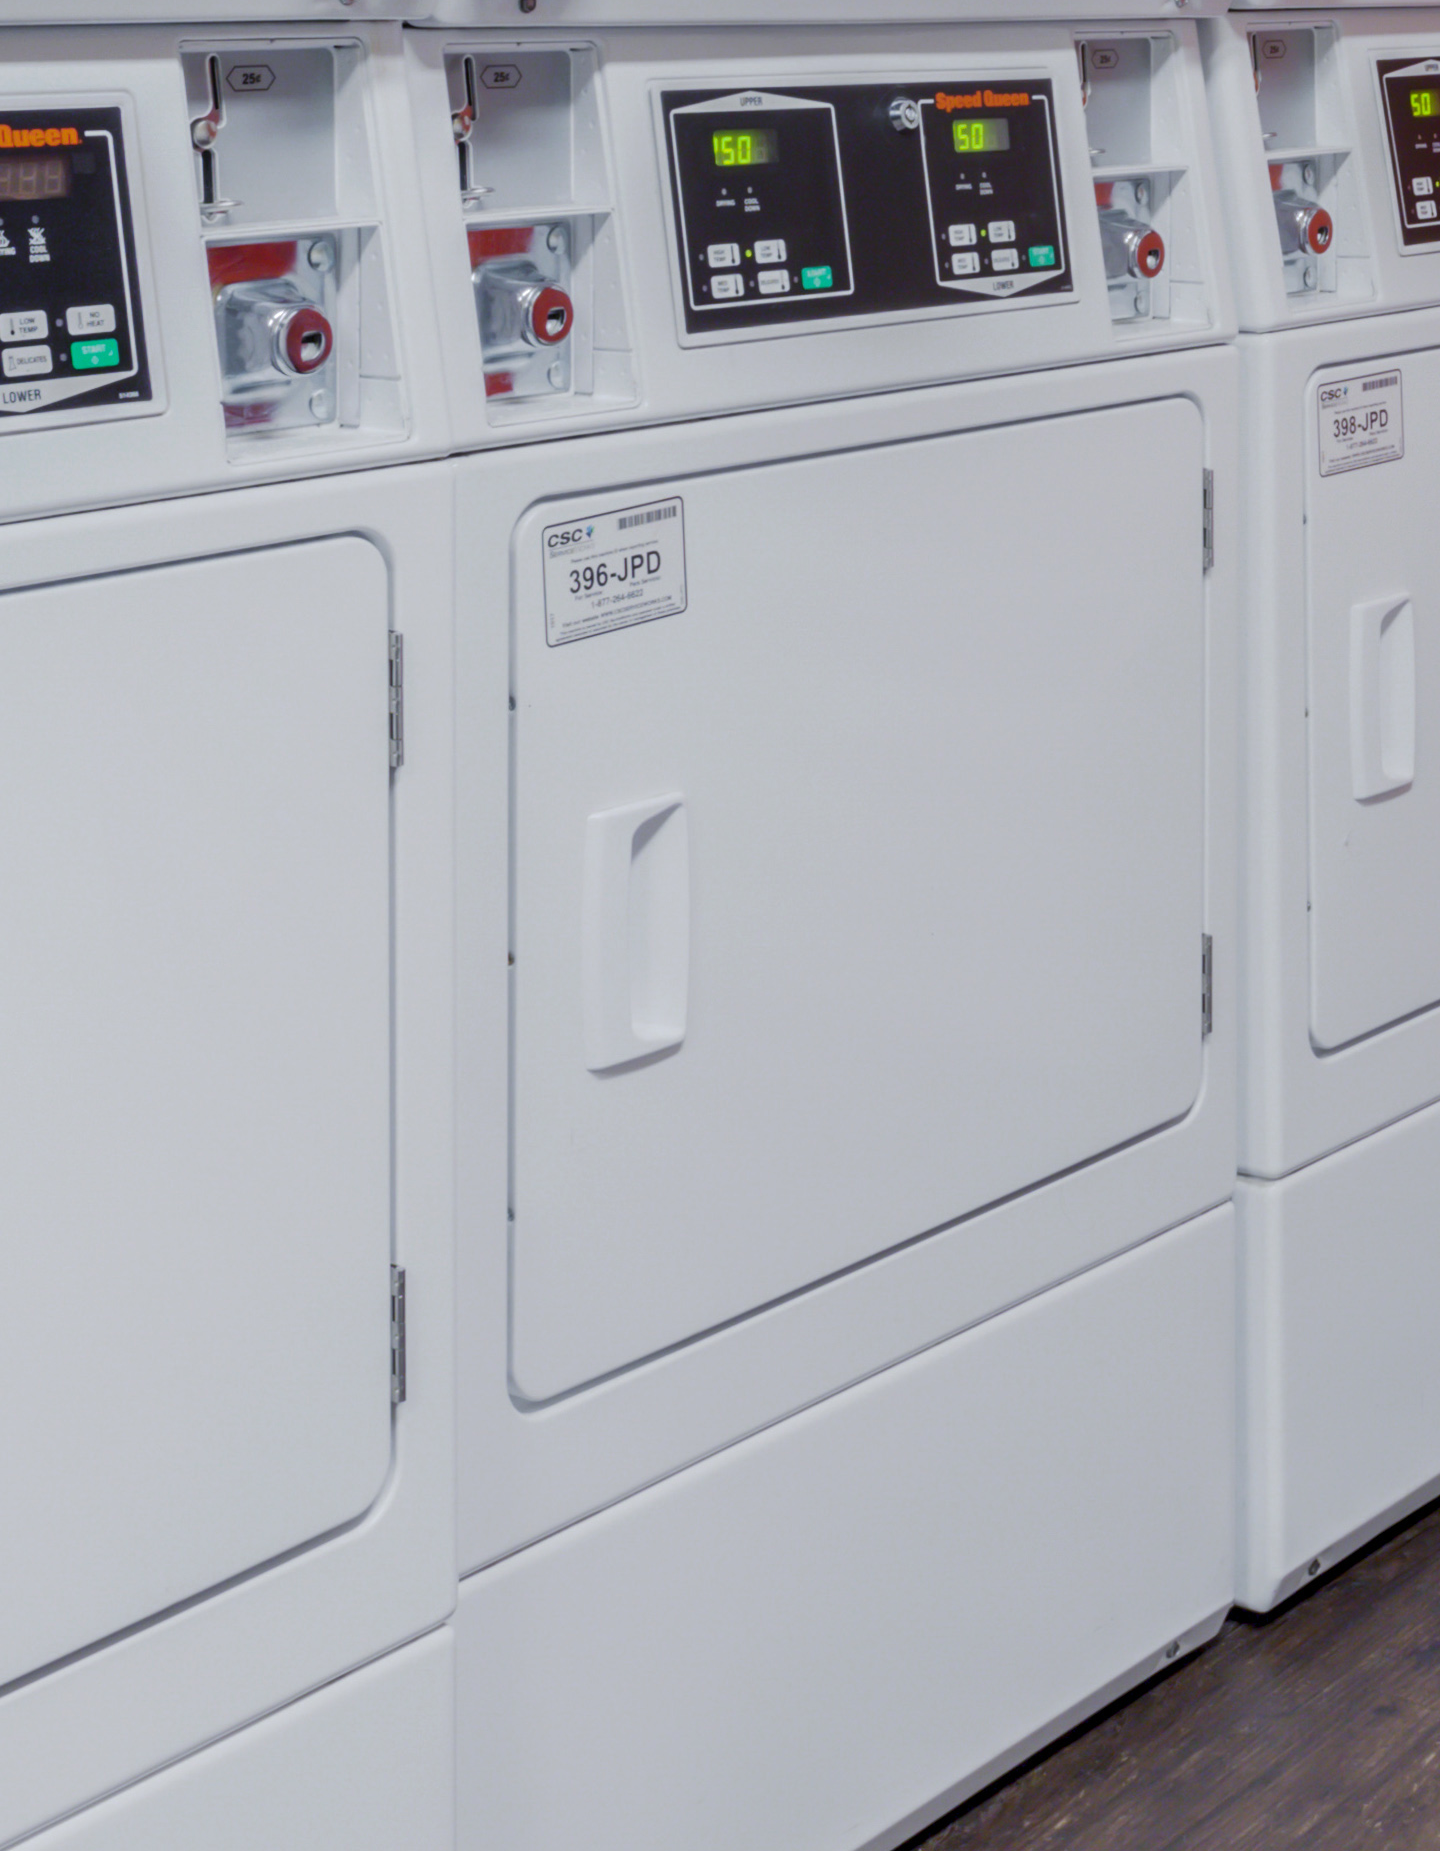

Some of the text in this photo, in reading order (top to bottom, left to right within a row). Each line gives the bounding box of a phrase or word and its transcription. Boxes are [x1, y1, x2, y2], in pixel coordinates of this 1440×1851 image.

[242, 72, 262, 85] 25¢
[493, 70, 512, 83] 25¢
[740, 97, 762, 106] UPPER
[935, 90, 1030, 113] Speed Queen
[1411, 93, 1432, 117] 50
[957, 124, 984, 150] 50
[29, 246, 48, 254] COOL
[29, 253, 50, 263] DOWN
[993, 281, 1014, 290] LOWER
[19, 317, 36, 326] LOW
[89, 311, 100, 319] NO
[19, 325, 38, 334] TEMP
[86, 319, 105, 328] HEAT
[16, 355, 47, 365] DELICATES
[3, 389, 42, 404] LOWER
[1320, 389, 1342, 402] CSC
[1333, 409, 1388, 438] 398-JPD
[548, 528, 583, 548] CSC
[569, 551, 661, 594] 396-JPD
